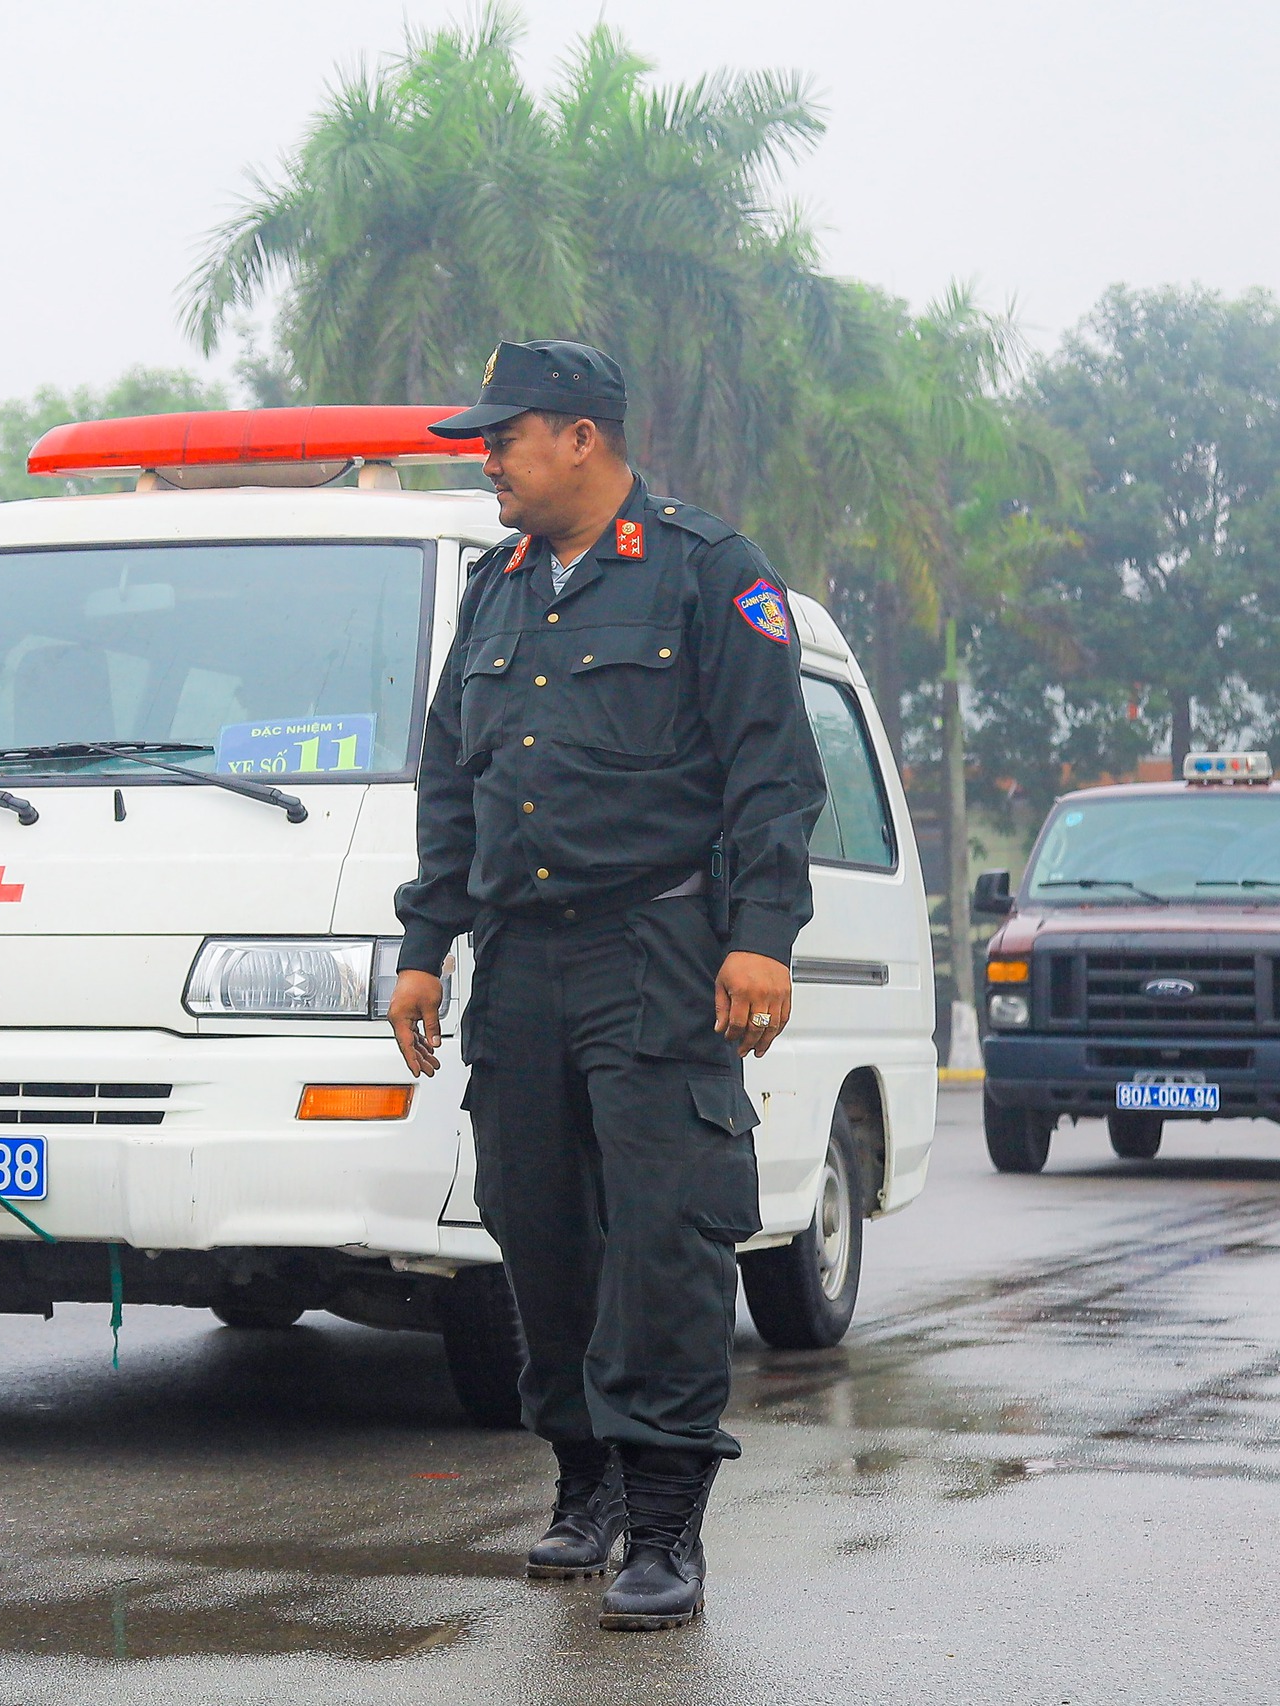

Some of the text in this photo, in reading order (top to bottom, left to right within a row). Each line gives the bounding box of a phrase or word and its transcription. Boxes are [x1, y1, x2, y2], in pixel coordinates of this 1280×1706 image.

[251, 722, 344, 738] ĐẶC NHIỆM 1
[228, 734, 363, 774] XE SỐ 11
